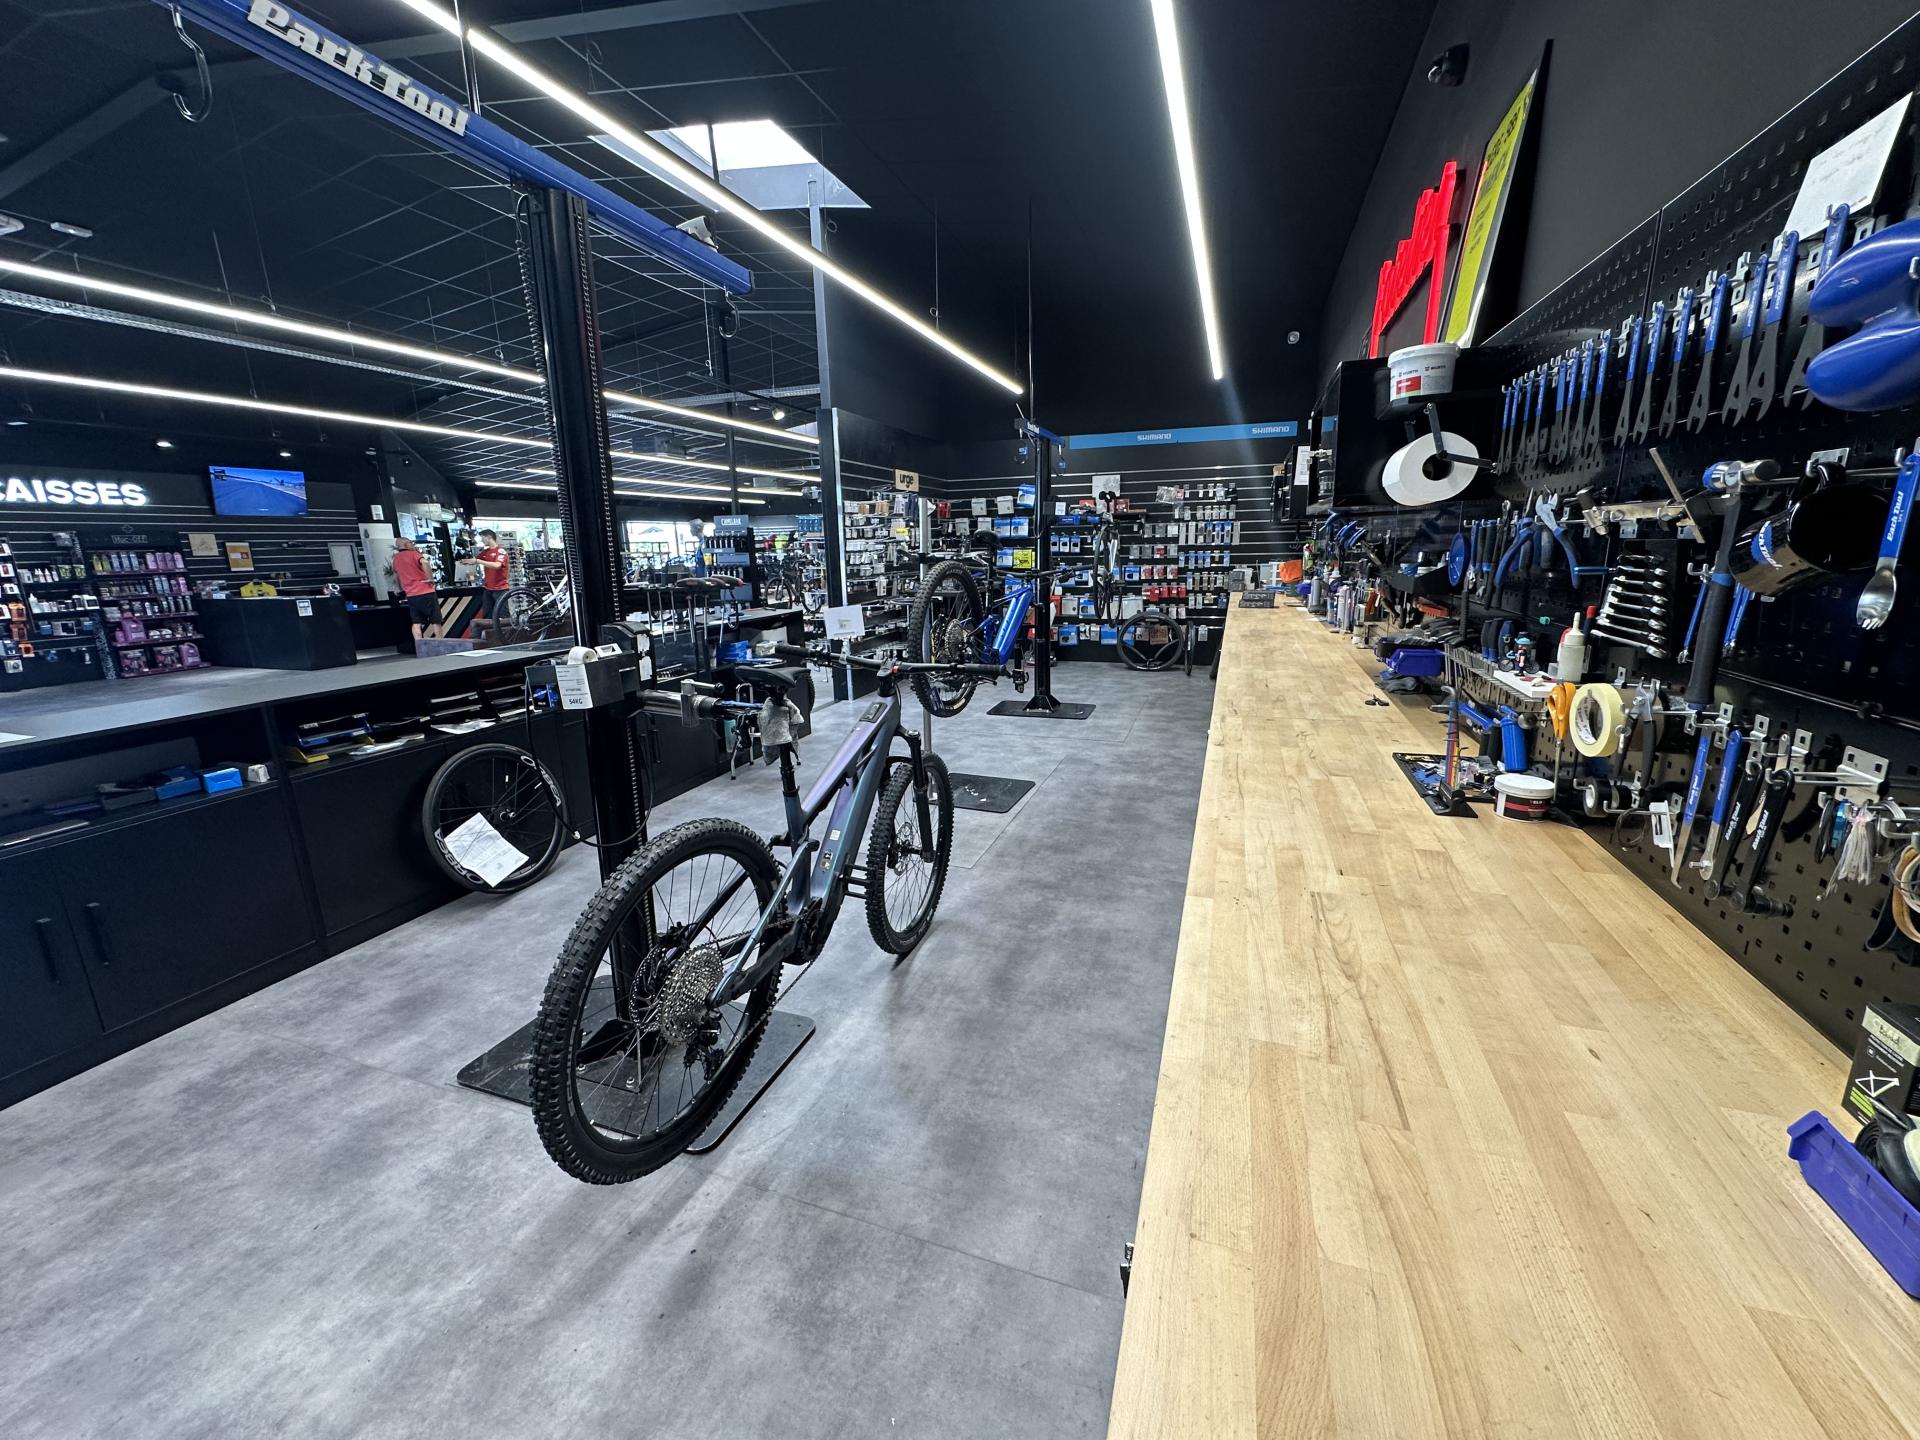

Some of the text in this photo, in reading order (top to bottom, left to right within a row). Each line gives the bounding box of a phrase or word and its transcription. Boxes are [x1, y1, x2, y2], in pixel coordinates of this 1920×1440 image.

[1251, 425, 1290, 434] SHIMANO
[1137, 432, 1172, 441] SHIMANO
[900, 473, 914, 488] urge
